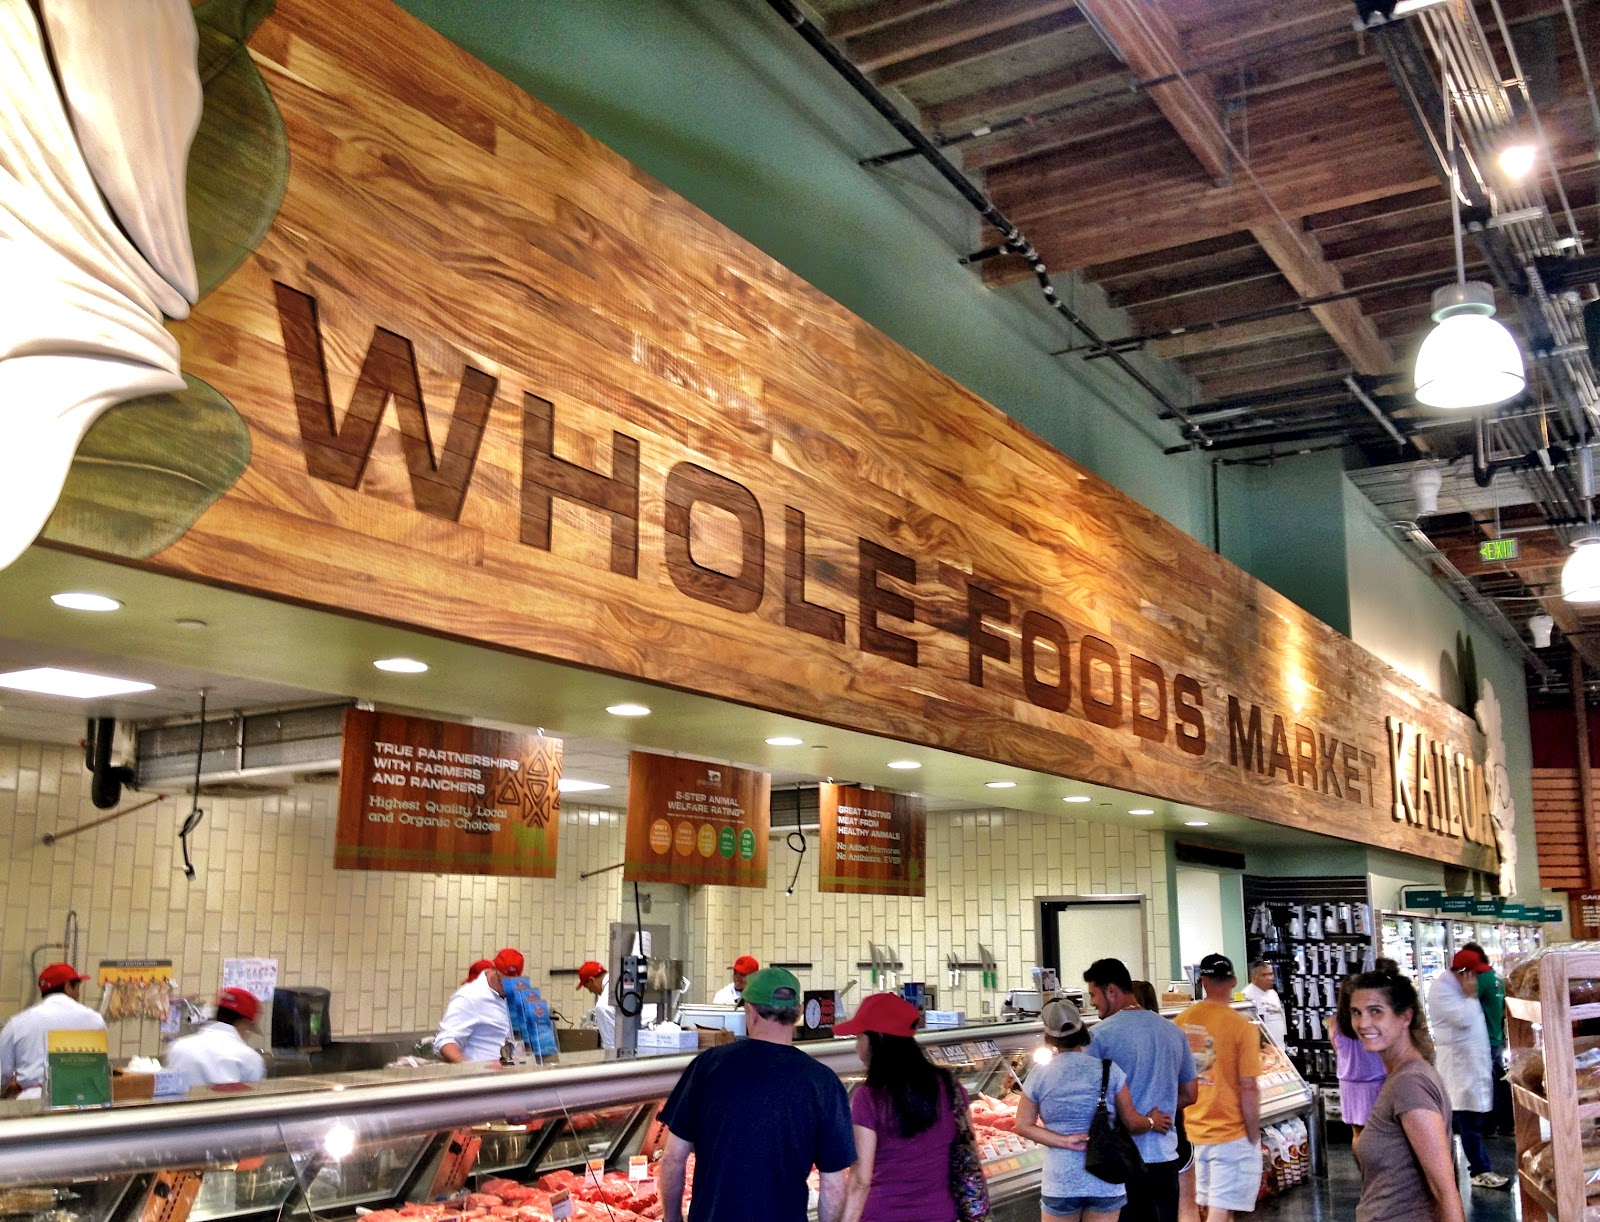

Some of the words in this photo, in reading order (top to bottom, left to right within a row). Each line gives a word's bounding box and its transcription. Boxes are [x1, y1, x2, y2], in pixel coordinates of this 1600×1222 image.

[273, 280, 918, 668] WHOLE
[968, 583, 1206, 755] FOODS
[1228, 694, 1376, 808] MARKET
[1485, 540, 1513, 560] EXIT
[374, 742, 413, 758] TRUE
[418, 747, 519, 771] PARTNERSHIPS
[373, 757, 410, 771] WITH
[415, 762, 481, 780] FARMERS
[372, 772, 406, 786] AND
[410, 776, 485, 795] RANCHERS
[1386, 715, 1497, 848] KAILUA
[369, 795, 420, 811] Highest
[477, 805, 508, 819] Local
[667, 801, 709, 813] WELFARE
[675, 790, 707, 802] 5-STEP
[708, 795, 739, 807] ANIMAL
[838, 805, 862, 815] GREAT
[863, 808, 892, 819] TASTING
[368, 812, 394, 823] and
[399, 813, 451, 828] Organic
[454, 818, 501, 831] Choices
[838, 816, 860, 827] MEAT
[860, 818, 879, 828] FROM
[838, 826, 869, 836] HEALTHY
[871, 831, 900, 840] ANIMALS
[837, 842, 846, 850] No
[848, 843, 869, 852] Added
[837, 852, 846, 860] No
[884, 856, 901, 865] EVER
[942, 1044, 965, 1057] LOCAL
[976, 1041, 998, 1052] LOCAL
